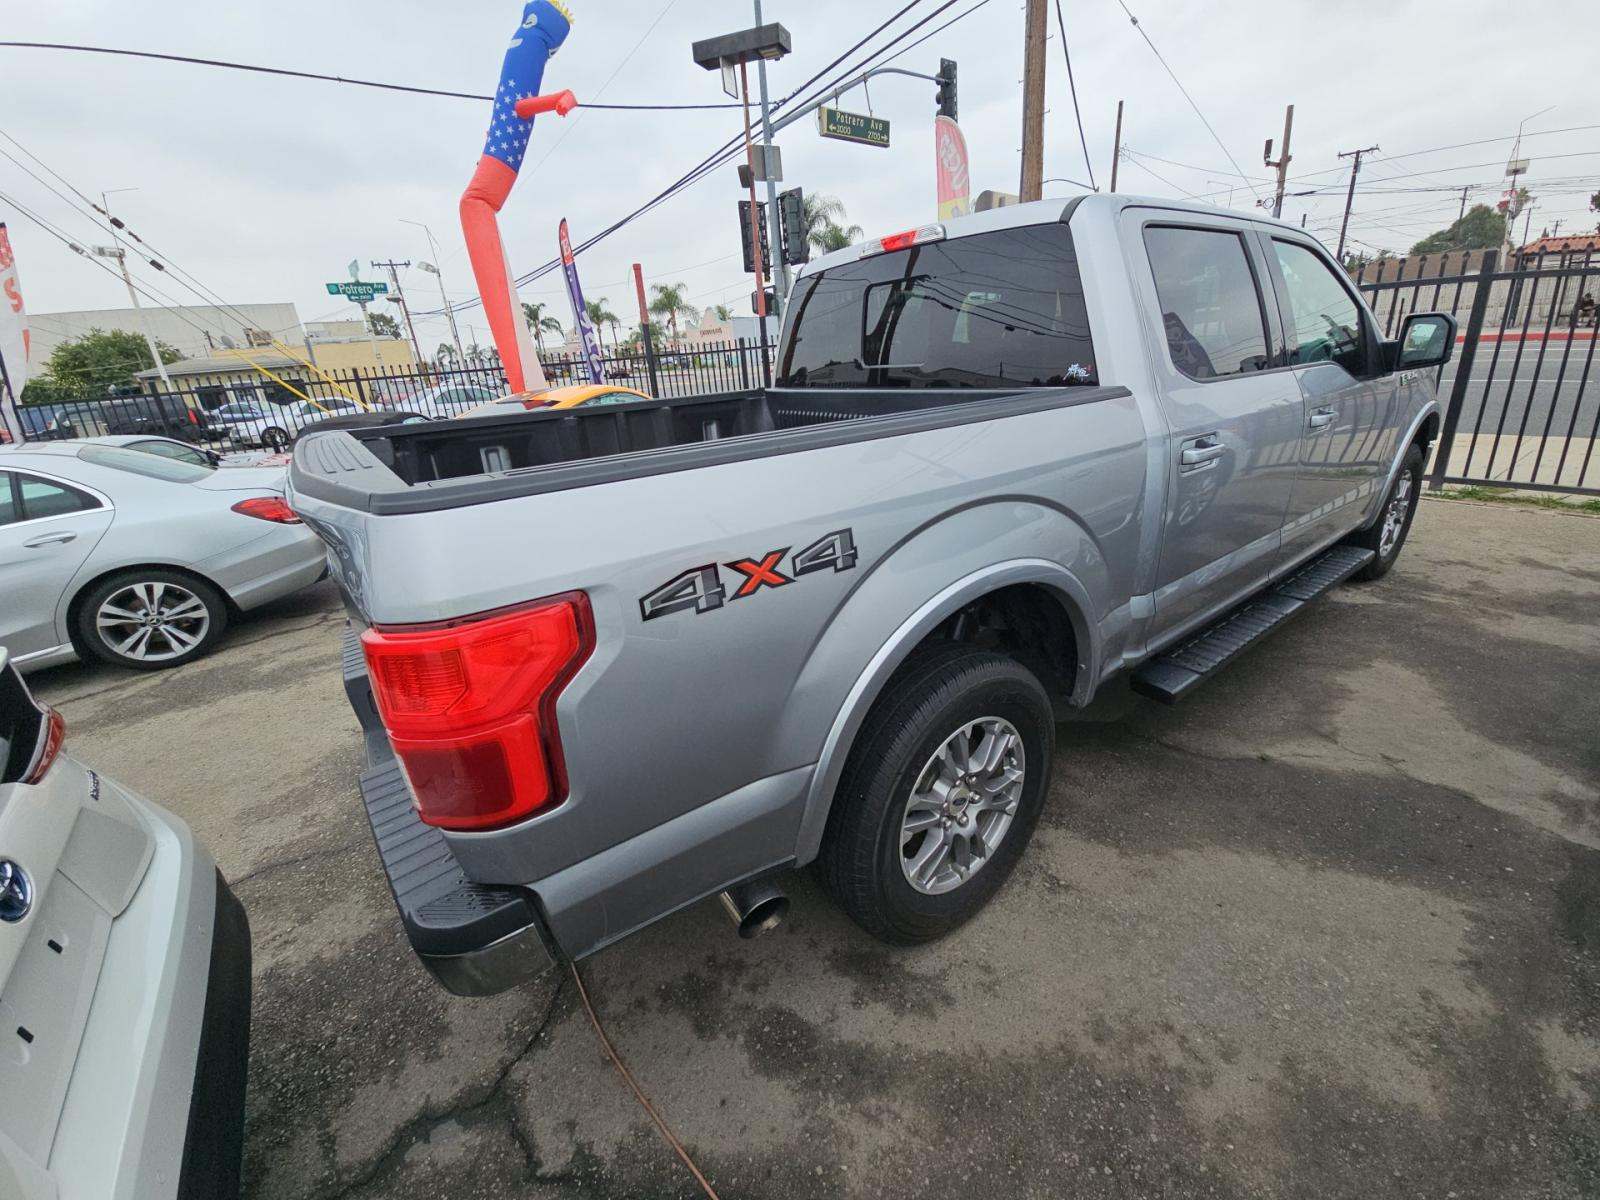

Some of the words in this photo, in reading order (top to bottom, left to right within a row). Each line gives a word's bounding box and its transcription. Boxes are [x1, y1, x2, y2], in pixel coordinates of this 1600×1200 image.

[836, 111, 864, 127] Potrero
[870, 119, 883, 131] Ave
[338, 283, 372, 295] Potrero
